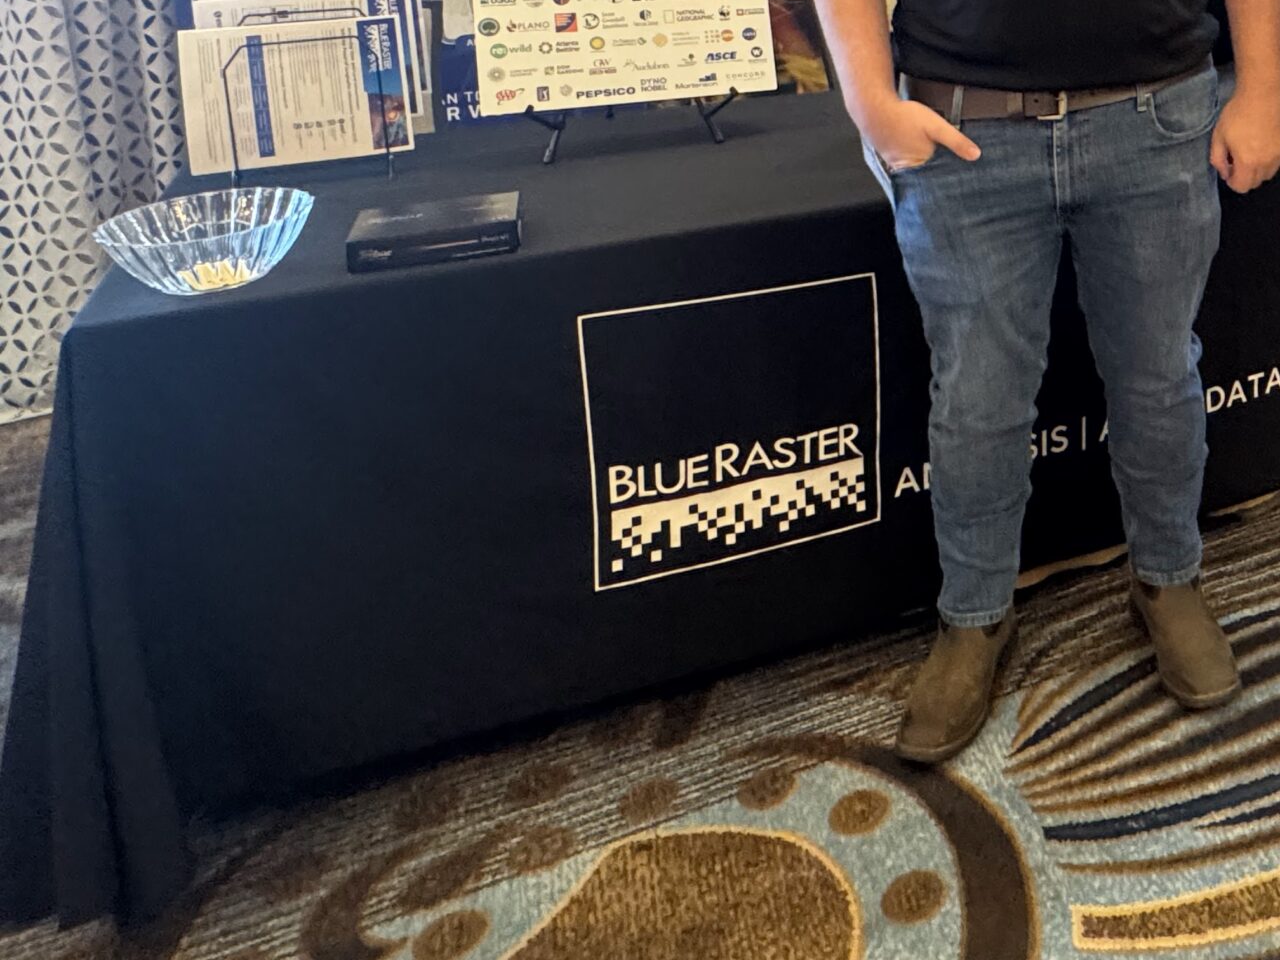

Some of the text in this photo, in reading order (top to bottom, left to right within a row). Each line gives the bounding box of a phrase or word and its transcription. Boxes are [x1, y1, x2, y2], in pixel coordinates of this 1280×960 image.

[517, 21, 550, 30] PLANO
[705, 51, 737, 62] ASCE
[576, 86, 636, 100] PEPSICO
